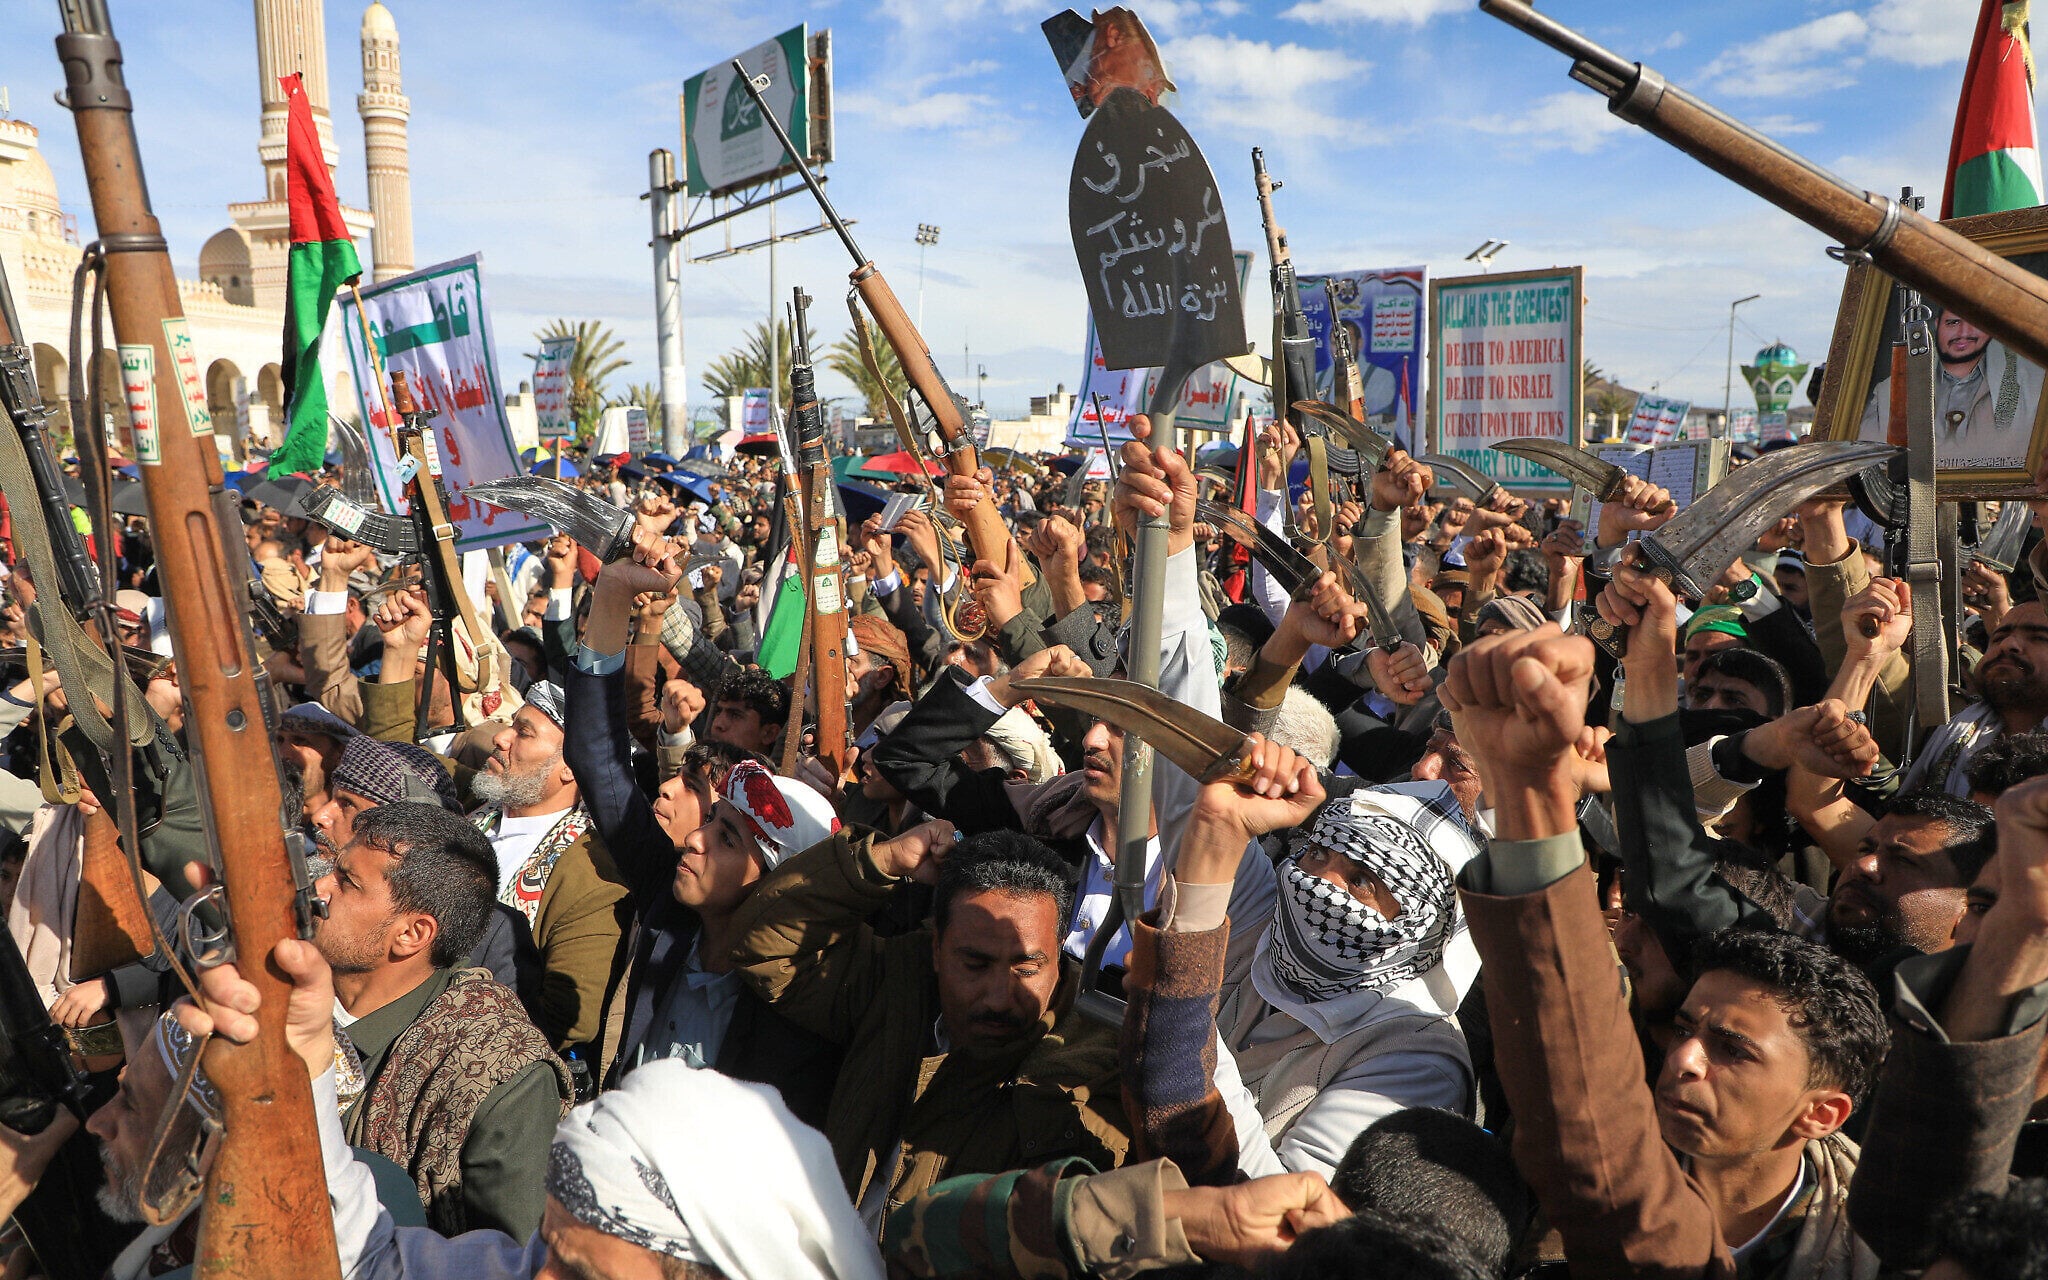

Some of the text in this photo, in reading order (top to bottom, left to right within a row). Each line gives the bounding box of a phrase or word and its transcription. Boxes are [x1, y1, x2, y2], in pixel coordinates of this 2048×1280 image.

[1122, 264, 1173, 318] الله
[1445, 286, 1569, 329] ALLAH IS THE GREATEST
[1446, 338, 1565, 367] DEATH TO AMERICA
[1446, 374, 1553, 401] DEATH TO ISRAEL
[1445, 411, 1564, 438] CURSE UPON THE JEWS
[1502, 452, 1520, 477] TO
